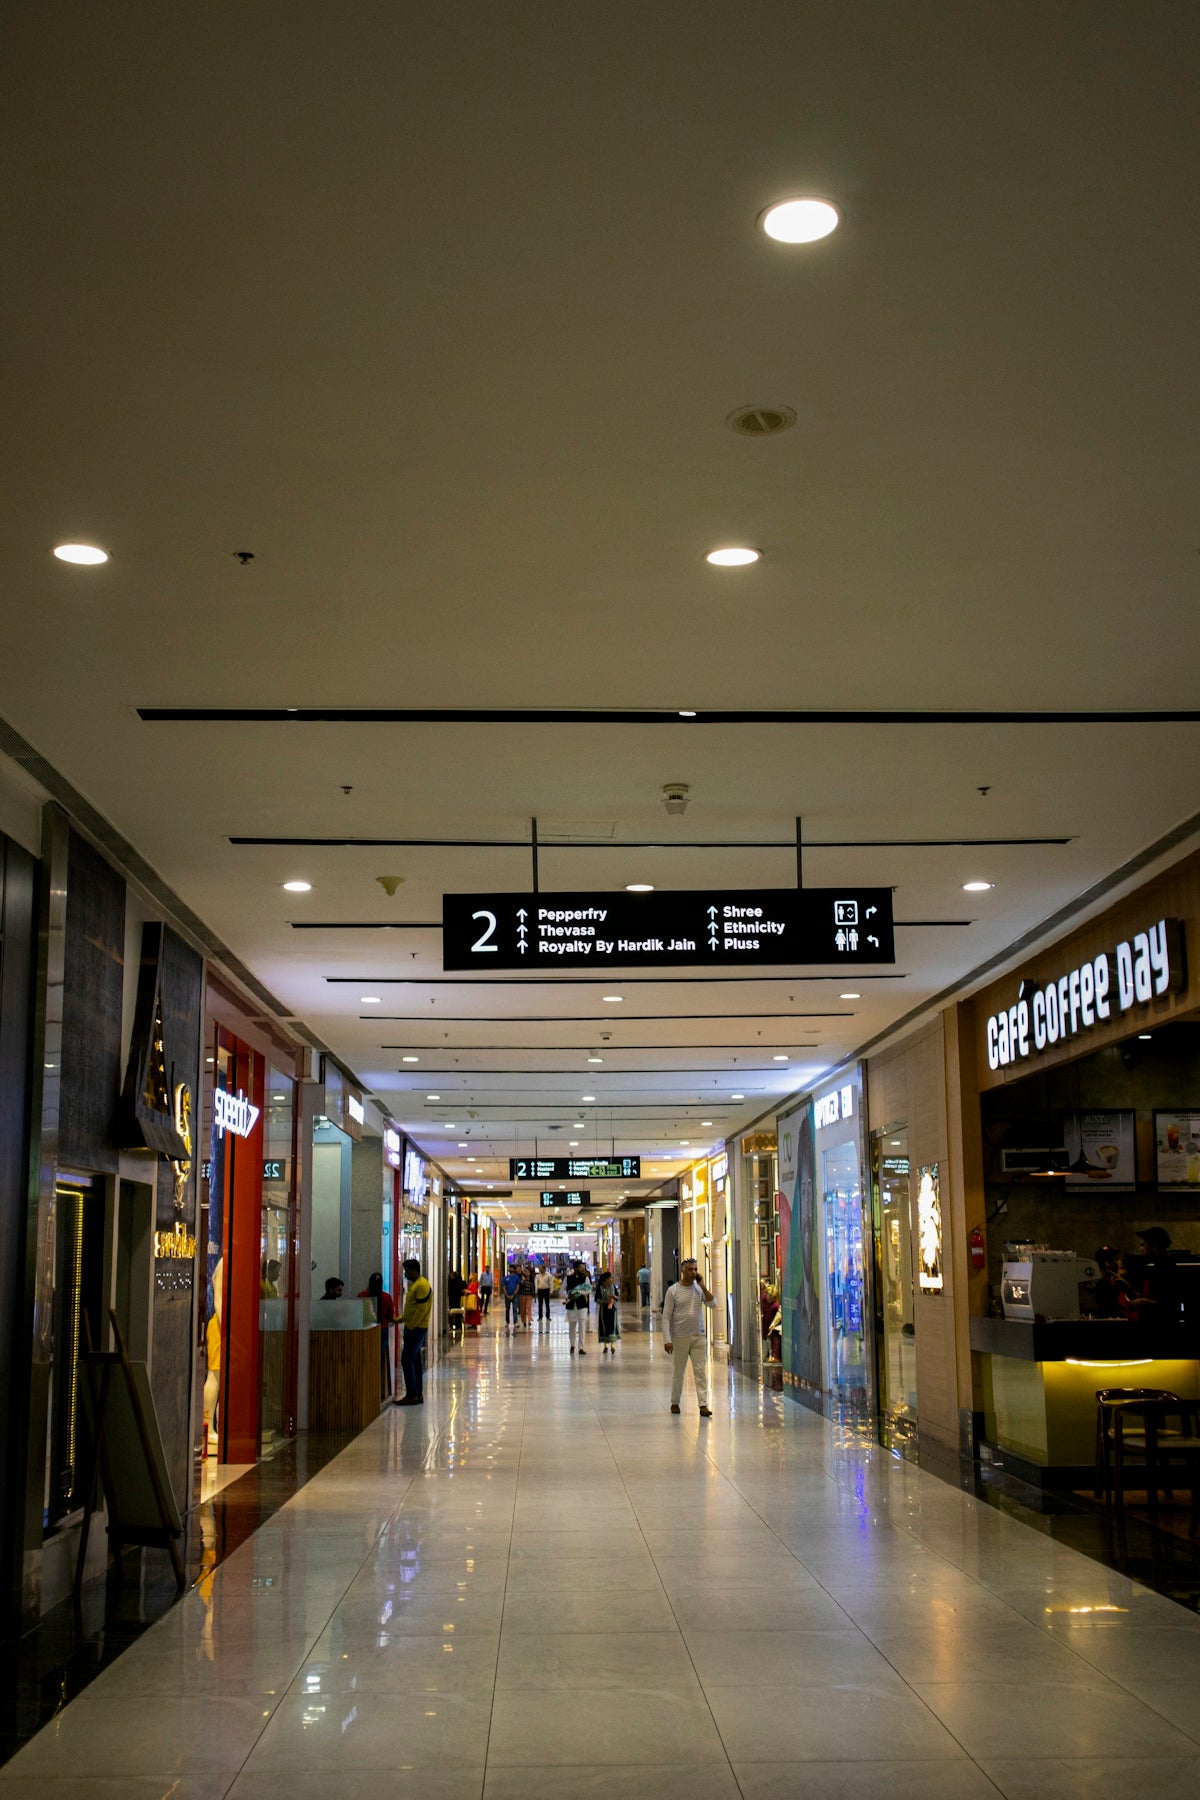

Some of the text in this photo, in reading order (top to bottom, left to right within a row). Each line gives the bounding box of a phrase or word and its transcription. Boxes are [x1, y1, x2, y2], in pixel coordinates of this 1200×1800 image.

[537, 908, 608, 922] Pepperfry
[722, 905, 764, 918] Shree
[470, 910, 499, 952] 2
[538, 924, 596, 937] Thevasa
[723, 921, 786, 935] Ethnicity
[538, 938, 697, 955] Royalty By Hardik Jain
[724, 938, 761, 950] Pluss
[1116, 919, 1170, 1011] Day
[517, 1162, 527, 1176] 2
